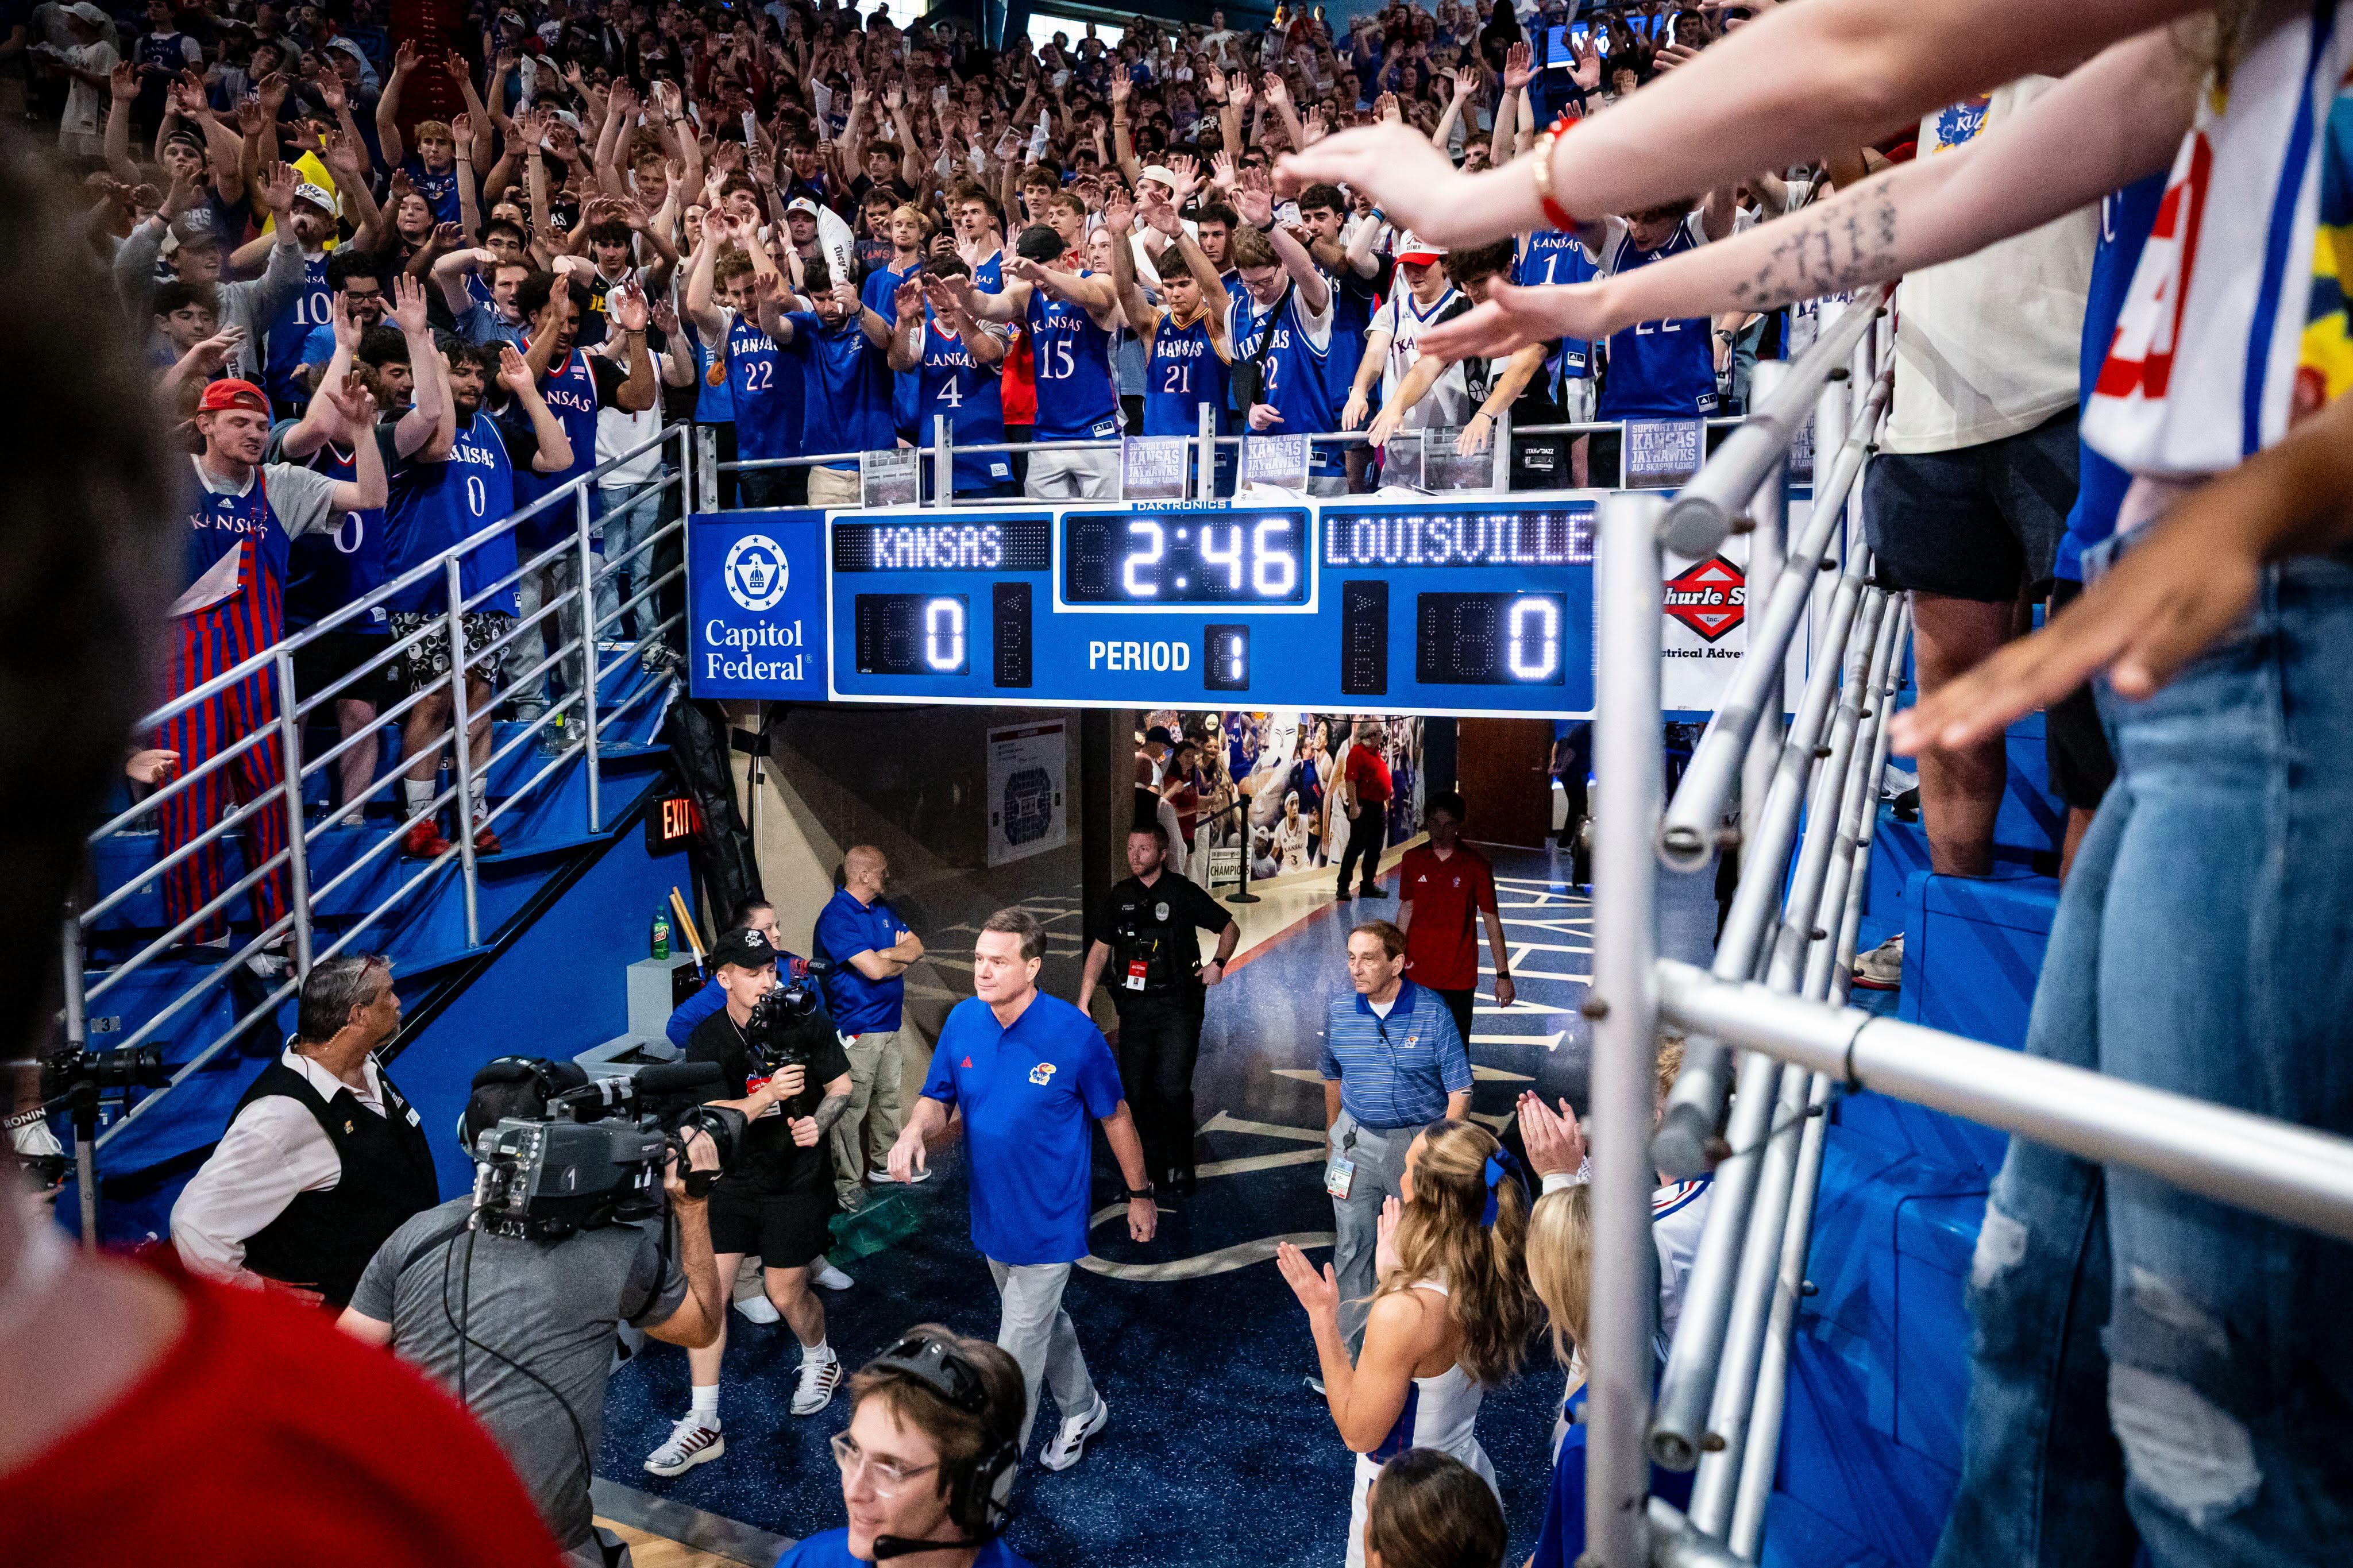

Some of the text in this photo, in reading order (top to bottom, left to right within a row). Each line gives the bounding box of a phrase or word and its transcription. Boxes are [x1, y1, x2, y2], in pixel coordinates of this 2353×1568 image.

[1533, 236, 1581, 252] KANSAS
[1540, 253, 1557, 285] 1
[292, 292, 333, 325] 10
[1157, 339, 1204, 358] KANSAS
[1239, 329, 1290, 361] KANAS
[1040, 340, 1075, 380] 15
[746, 361, 773, 391] 22
[1164, 365, 1191, 393] 21
[937, 374, 963, 408] 4
[1632, 422, 1696, 434] SUPPORT YOUR
[1129, 441, 1179, 451] SUPPORT YOUR
[1632, 430, 1696, 450] KANSAS
[1129, 449, 1179, 466] KANSAS
[1248, 441, 1302, 460] KANSAS
[1631, 446, 1695, 464] JAYHAWKS
[1128, 464, 1179, 478] JAYHAWKS
[1247, 456, 1301, 471] JAYHAWKS
[1247, 470, 1259, 478] ALL
[1259, 468, 1283, 477] SEASON
[1631, 461, 1695, 472] ALL SEASON LONG!
[1128, 477, 1139, 485] ALL
[467, 476, 485, 517] 0
[1137, 500, 1226, 511] DAKTRONICS
[875, 526, 1001, 567] KANSAS
[1327, 514, 1593, 563] LOUISVILLE
[1123, 519, 1295, 596] 2:46
[705, 619, 803, 652] Capitol
[926, 598, 963, 669] 0
[1509, 598, 1557, 679] 0
[1089, 640, 1190, 671] PERIOD
[1232, 636, 1241, 679] 1
[705, 653, 804, 681] Federal
[442, 758, 449, 769] 5
[663, 798, 689, 839] EXIT
[1284, 843, 1303, 852] KANSAS
[1210, 864, 1250, 877] CHAMPIOS
[1291, 855, 1298, 866] 3
[809, 961, 826, 970] RØDE
[101, 1018, 111, 1032] 3
[568, 1167, 576, 1191] 1
